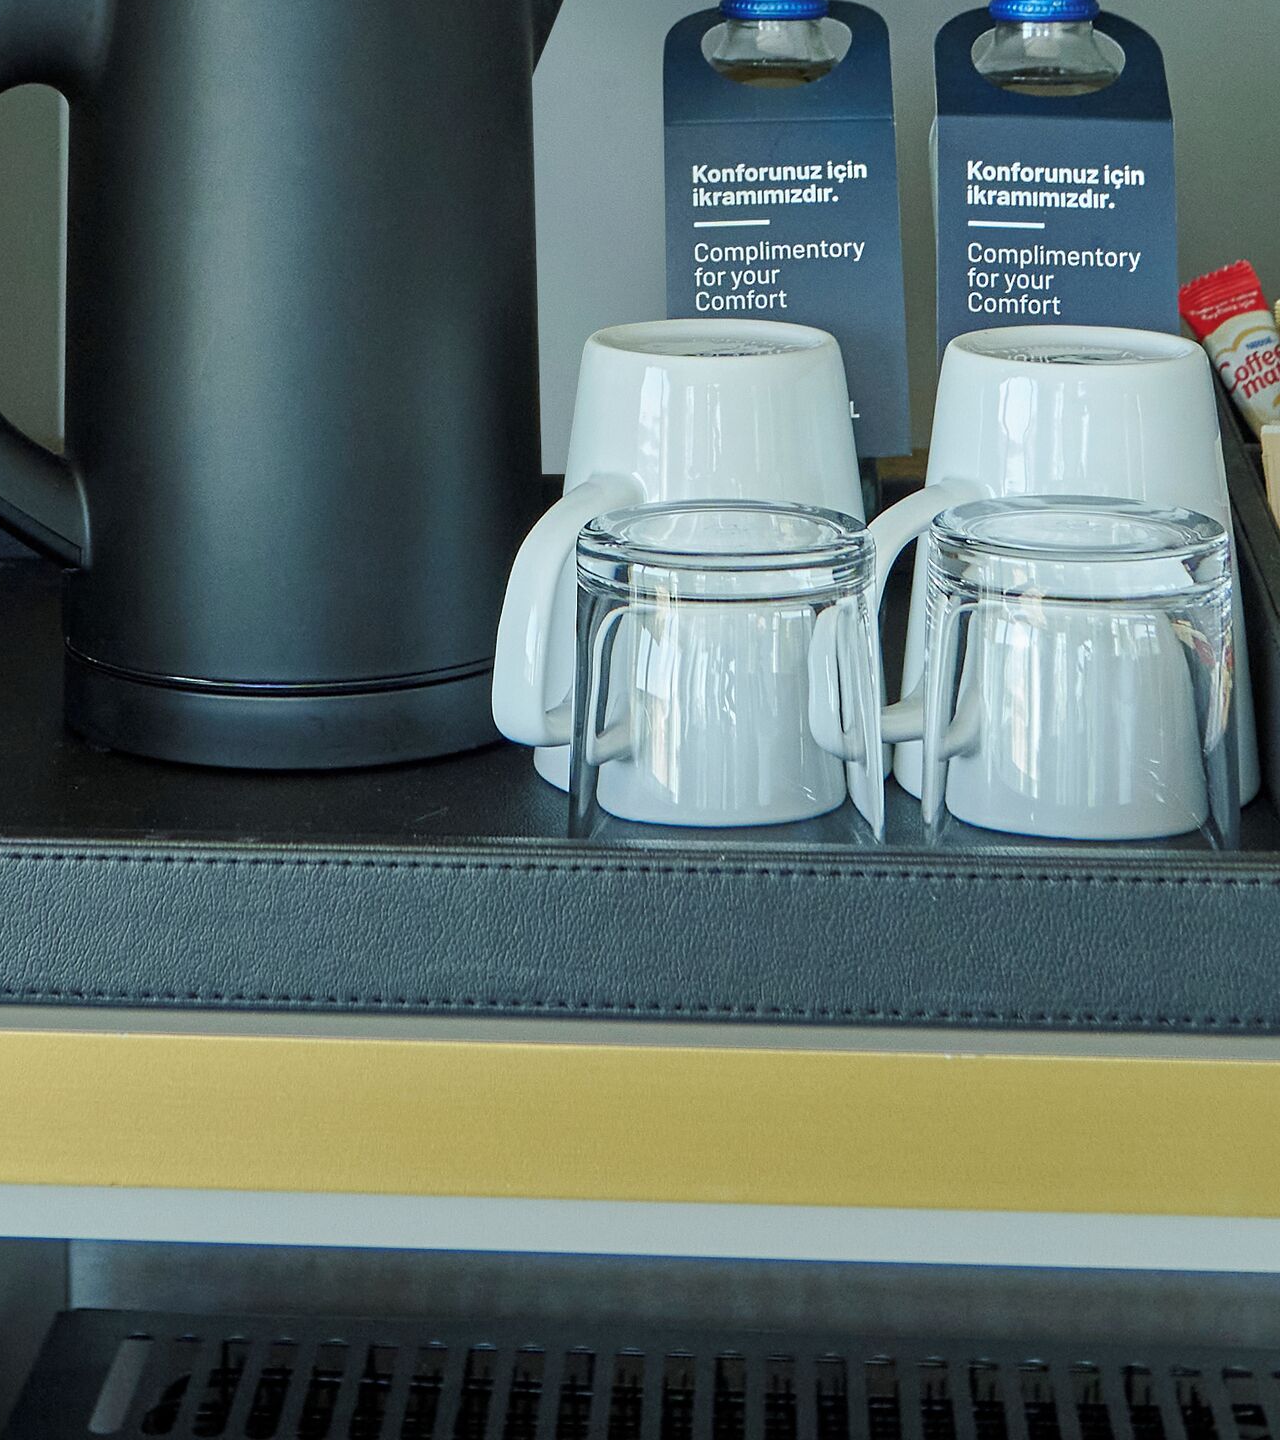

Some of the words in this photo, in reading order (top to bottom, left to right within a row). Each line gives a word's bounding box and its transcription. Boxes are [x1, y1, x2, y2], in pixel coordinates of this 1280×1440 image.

[692, 163, 822, 184] Konforunuz
[827, 160, 868, 183] için
[967, 160, 1099, 185] Konforunuz
[1103, 164, 1145, 189] için
[692, 184, 839, 207] ikramımızdır.
[967, 185, 1115, 209] ikramımızdır.
[694, 240, 865, 265] Complimentory
[967, 242, 1141, 272] Complimentory
[694, 267, 726, 287] for
[731, 269, 780, 290] your
[967, 267, 999, 288] for
[1004, 273, 1054, 293] your
[695, 290, 787, 311] Comfort
[967, 292, 1061, 315] Comfort
